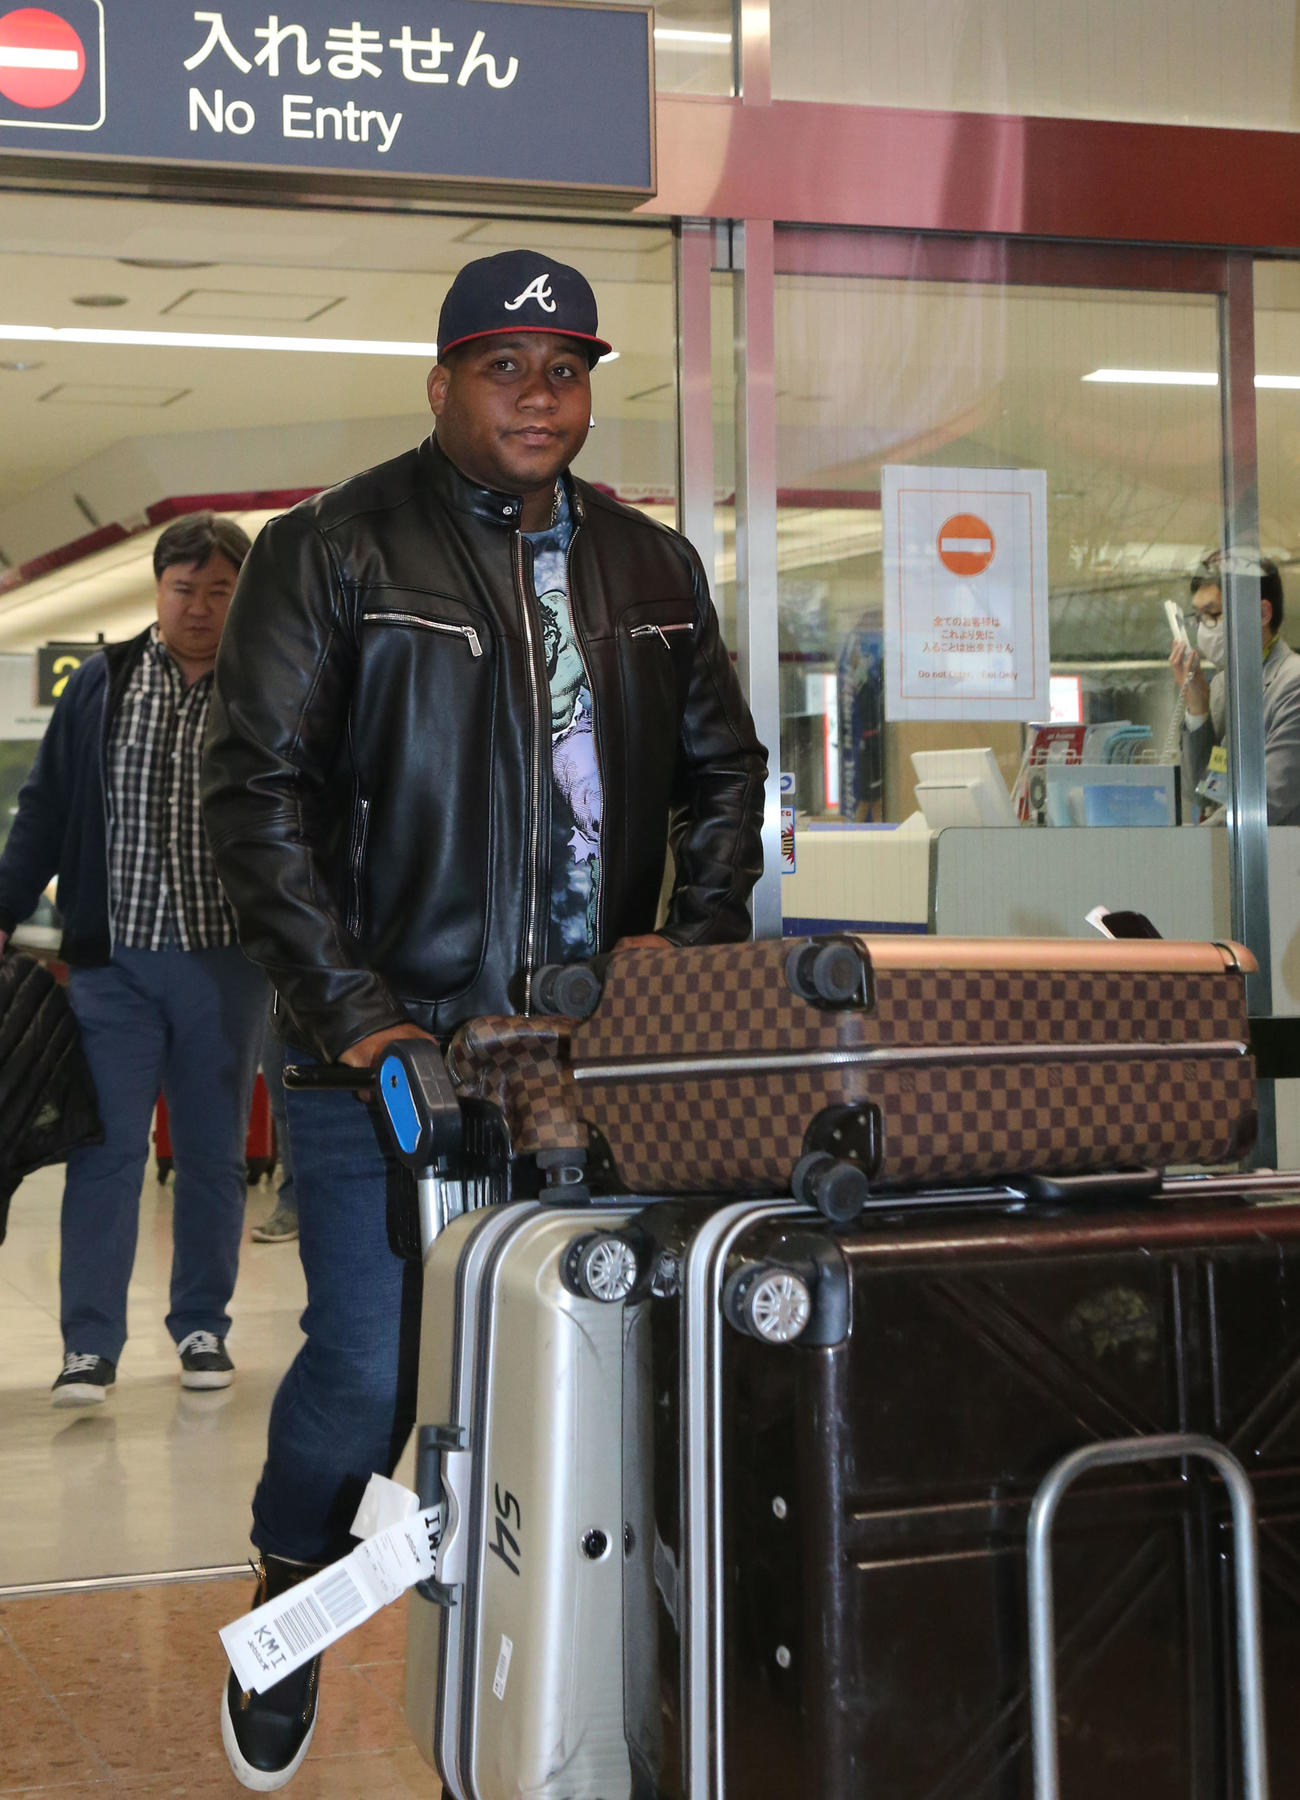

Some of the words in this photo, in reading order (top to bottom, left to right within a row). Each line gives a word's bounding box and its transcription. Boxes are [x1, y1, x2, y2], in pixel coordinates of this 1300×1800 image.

[183, 11, 519, 89] 入れません
[188, 88, 256, 135] No
[282, 94, 403, 153] Entry
[504, 273, 557, 313] A
[941, 630, 994, 641] これより先に
[918, 670, 931, 679] Do
[932, 670, 947, 679] not
[253, 1624, 287, 1670] KMI
